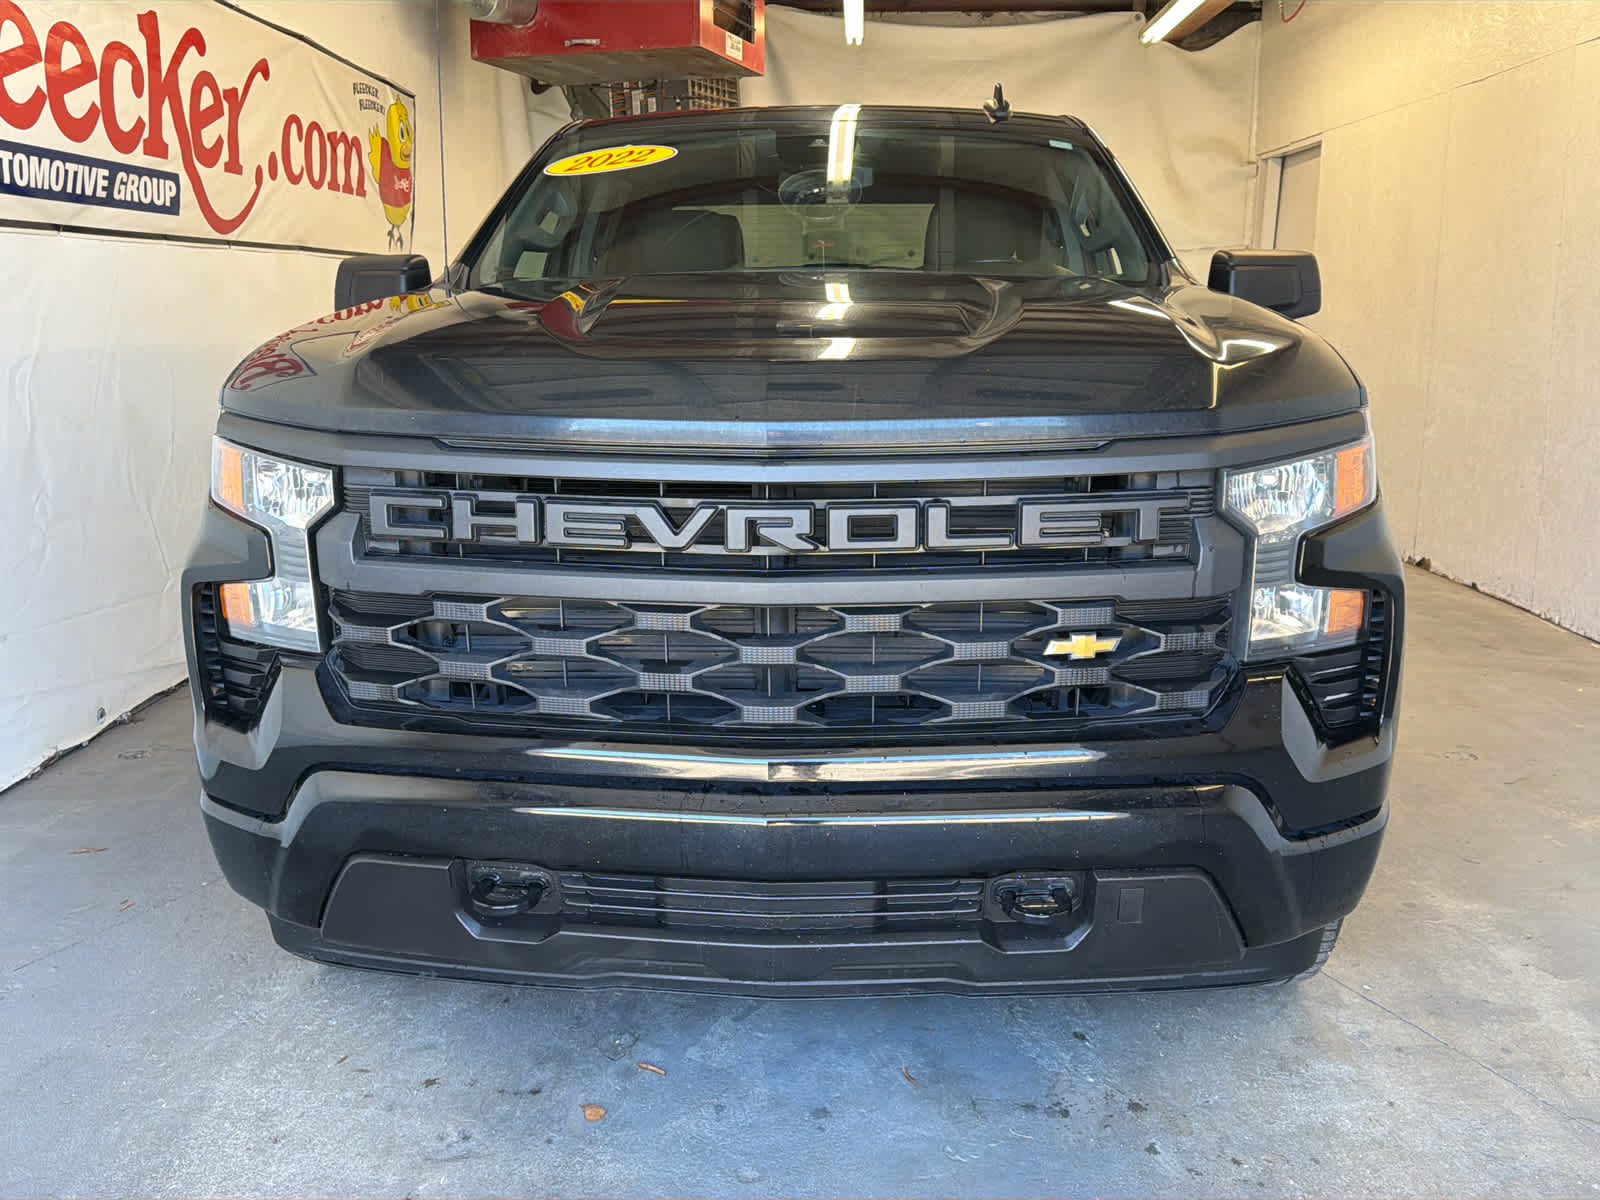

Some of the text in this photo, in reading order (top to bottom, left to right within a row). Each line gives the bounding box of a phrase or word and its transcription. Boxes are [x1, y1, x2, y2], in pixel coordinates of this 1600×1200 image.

[565, 149, 656, 172] 2022
[113, 171, 177, 207] GROUP
[369, 490, 1191, 556] CHEVROLET
